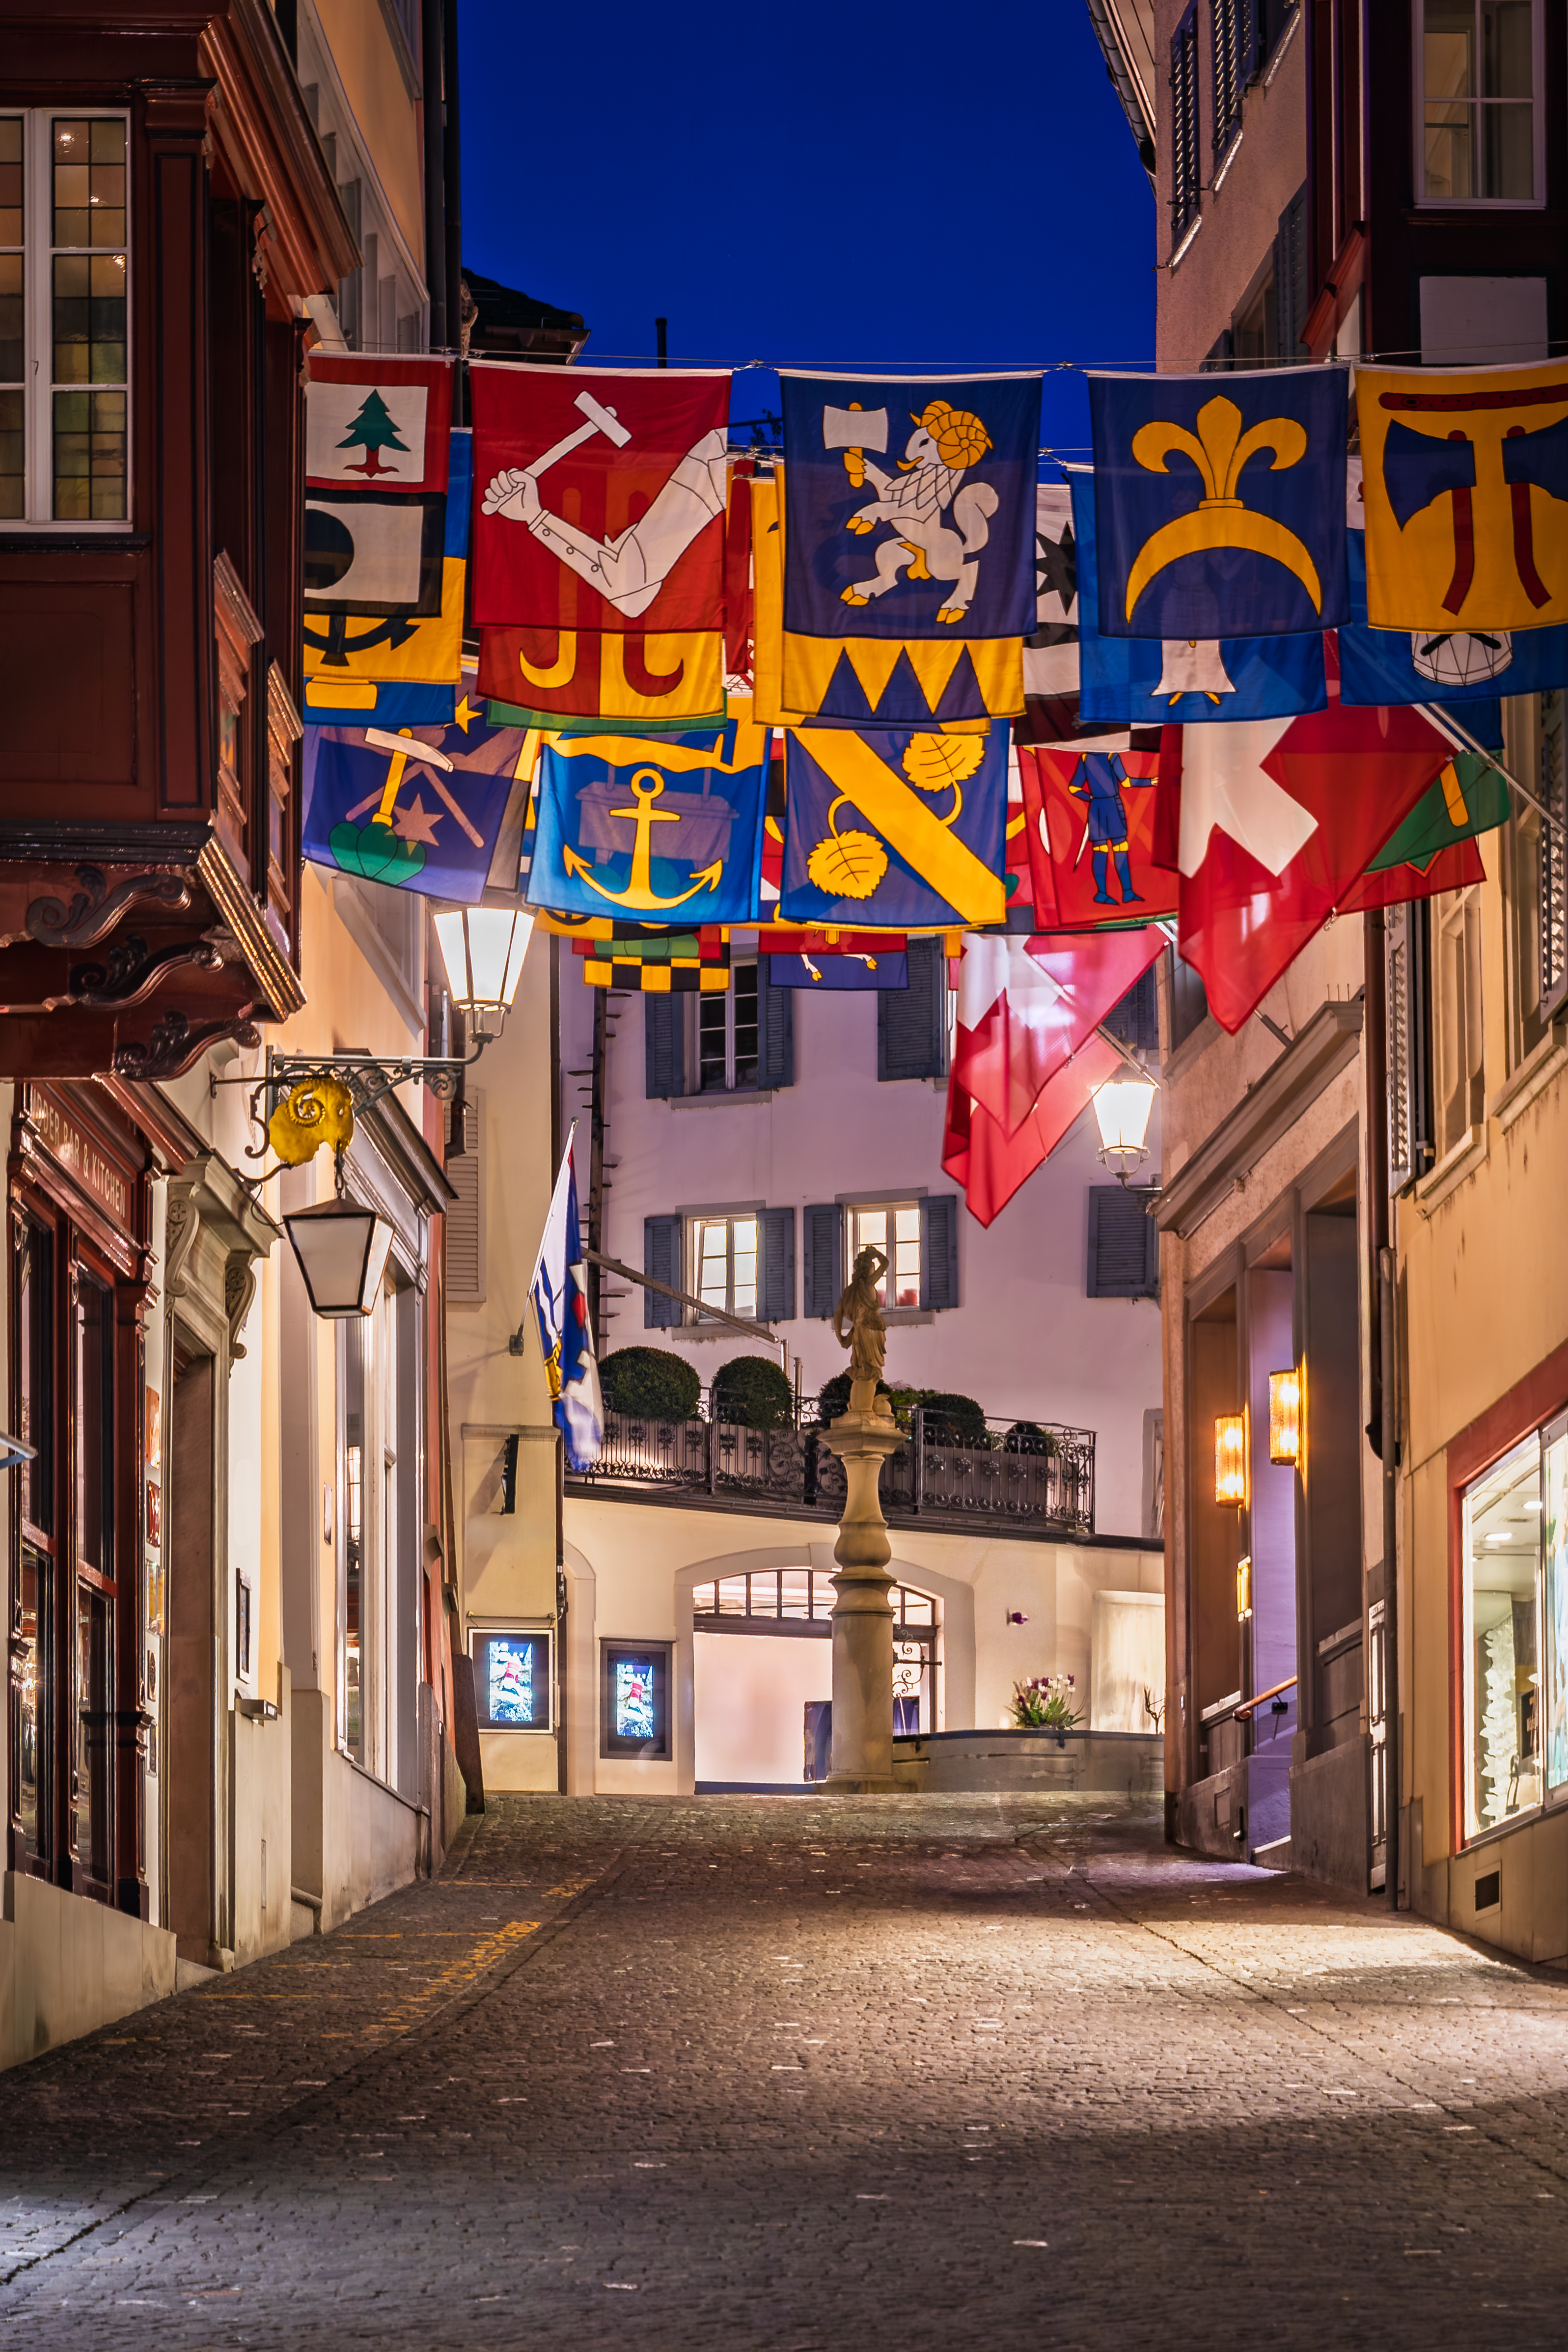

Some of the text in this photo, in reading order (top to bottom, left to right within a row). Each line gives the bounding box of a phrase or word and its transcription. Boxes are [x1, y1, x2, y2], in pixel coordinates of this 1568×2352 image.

[63, 1120, 79, 1169] BAR
[83, 1143, 89, 1179] &
[92, 1152, 125, 1218] KITCHEN
